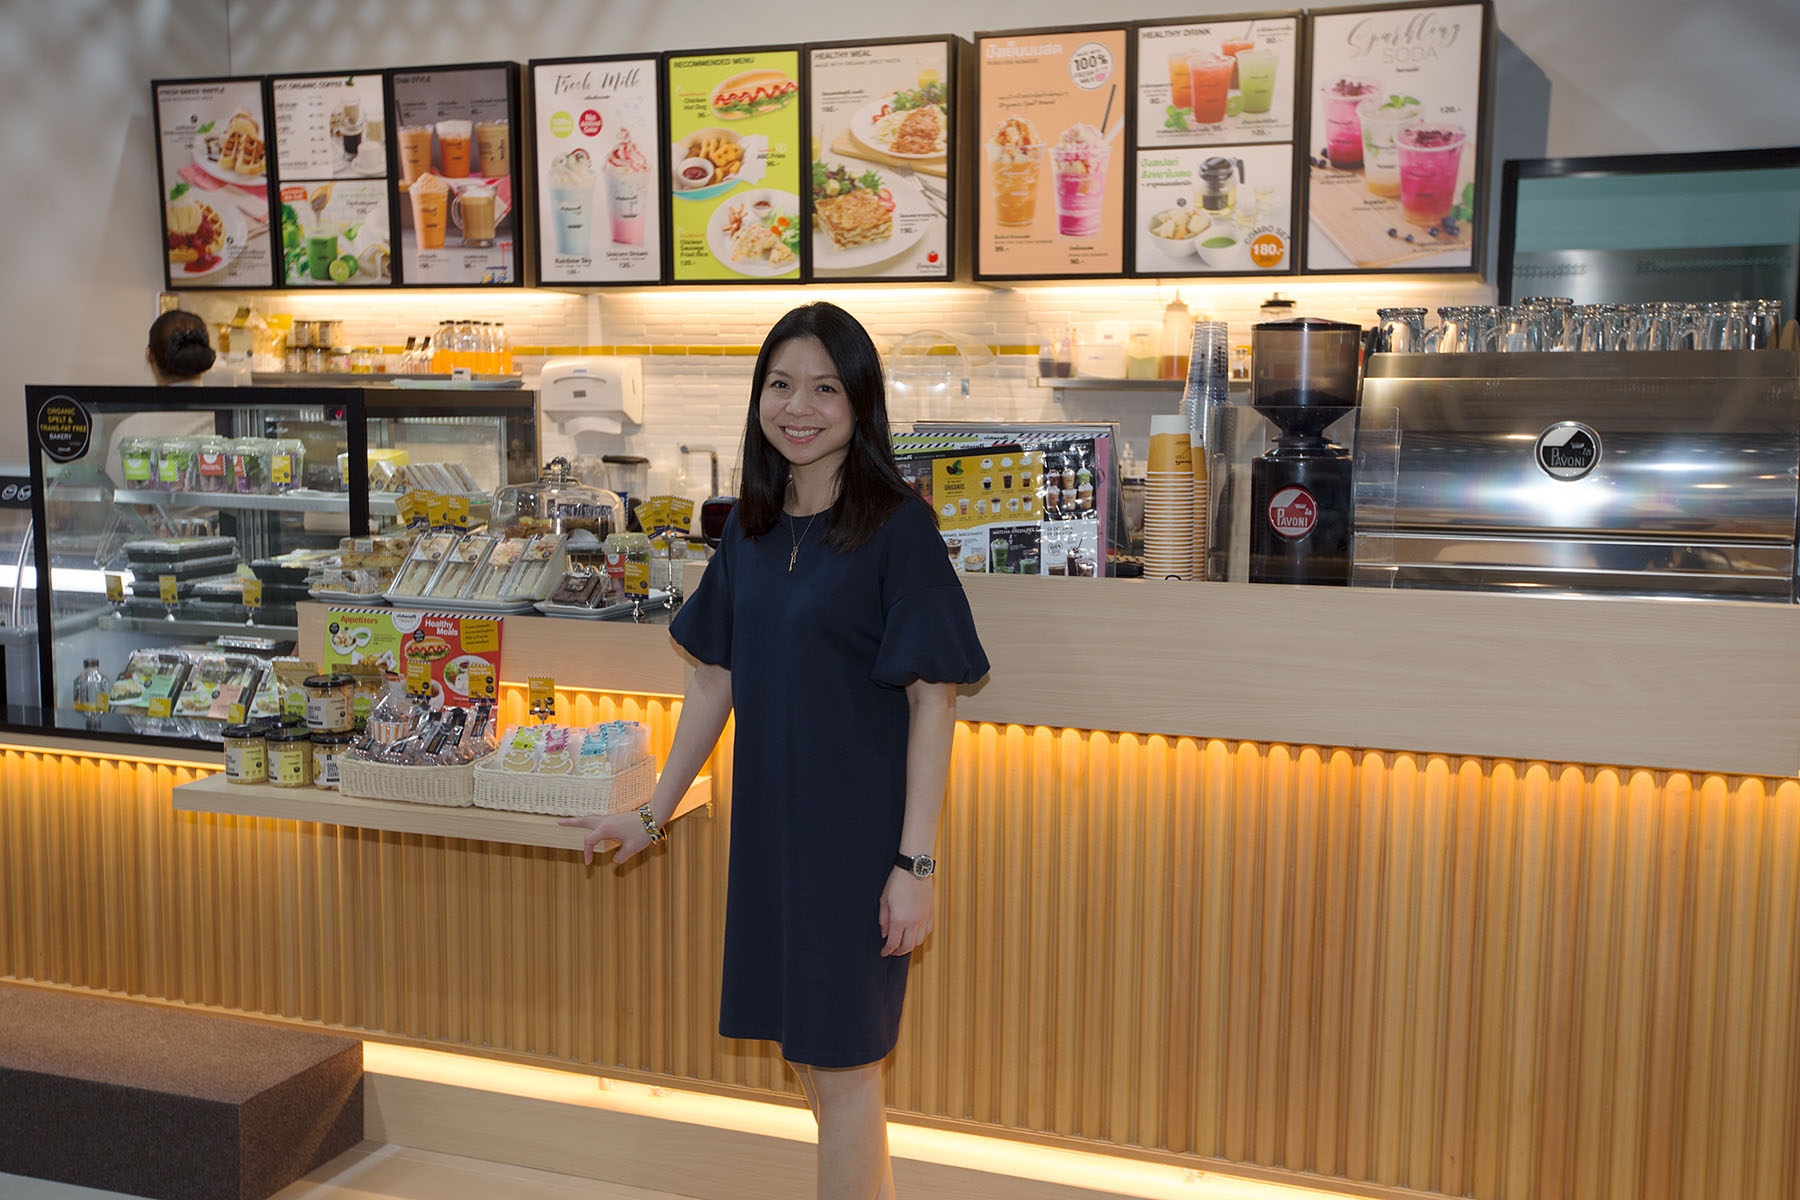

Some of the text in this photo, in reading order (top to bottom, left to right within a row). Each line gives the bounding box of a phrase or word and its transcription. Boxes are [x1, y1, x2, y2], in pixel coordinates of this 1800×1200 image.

[1141, 28, 1211, 39] HEALTHY DRINK
[814, 51, 849, 60] HEALTHY
[1383, 47, 1439, 64] SODA
[673, 59, 731, 68] RECOMMENDED
[1074, 54, 1108, 71] 100%
[1244, 225, 1274, 245] COMBO
[1252, 243, 1286, 256] 180.-
[47, 407, 76, 415] ORGANIC
[47, 415, 67, 423] SPELT
[72, 424, 87, 433] FREE
[944, 483, 965, 491] ORGANIC
[340, 615, 378, 625] Appetizers
[425, 619, 454, 631] Healthy
[436, 627, 459, 637] Meals
